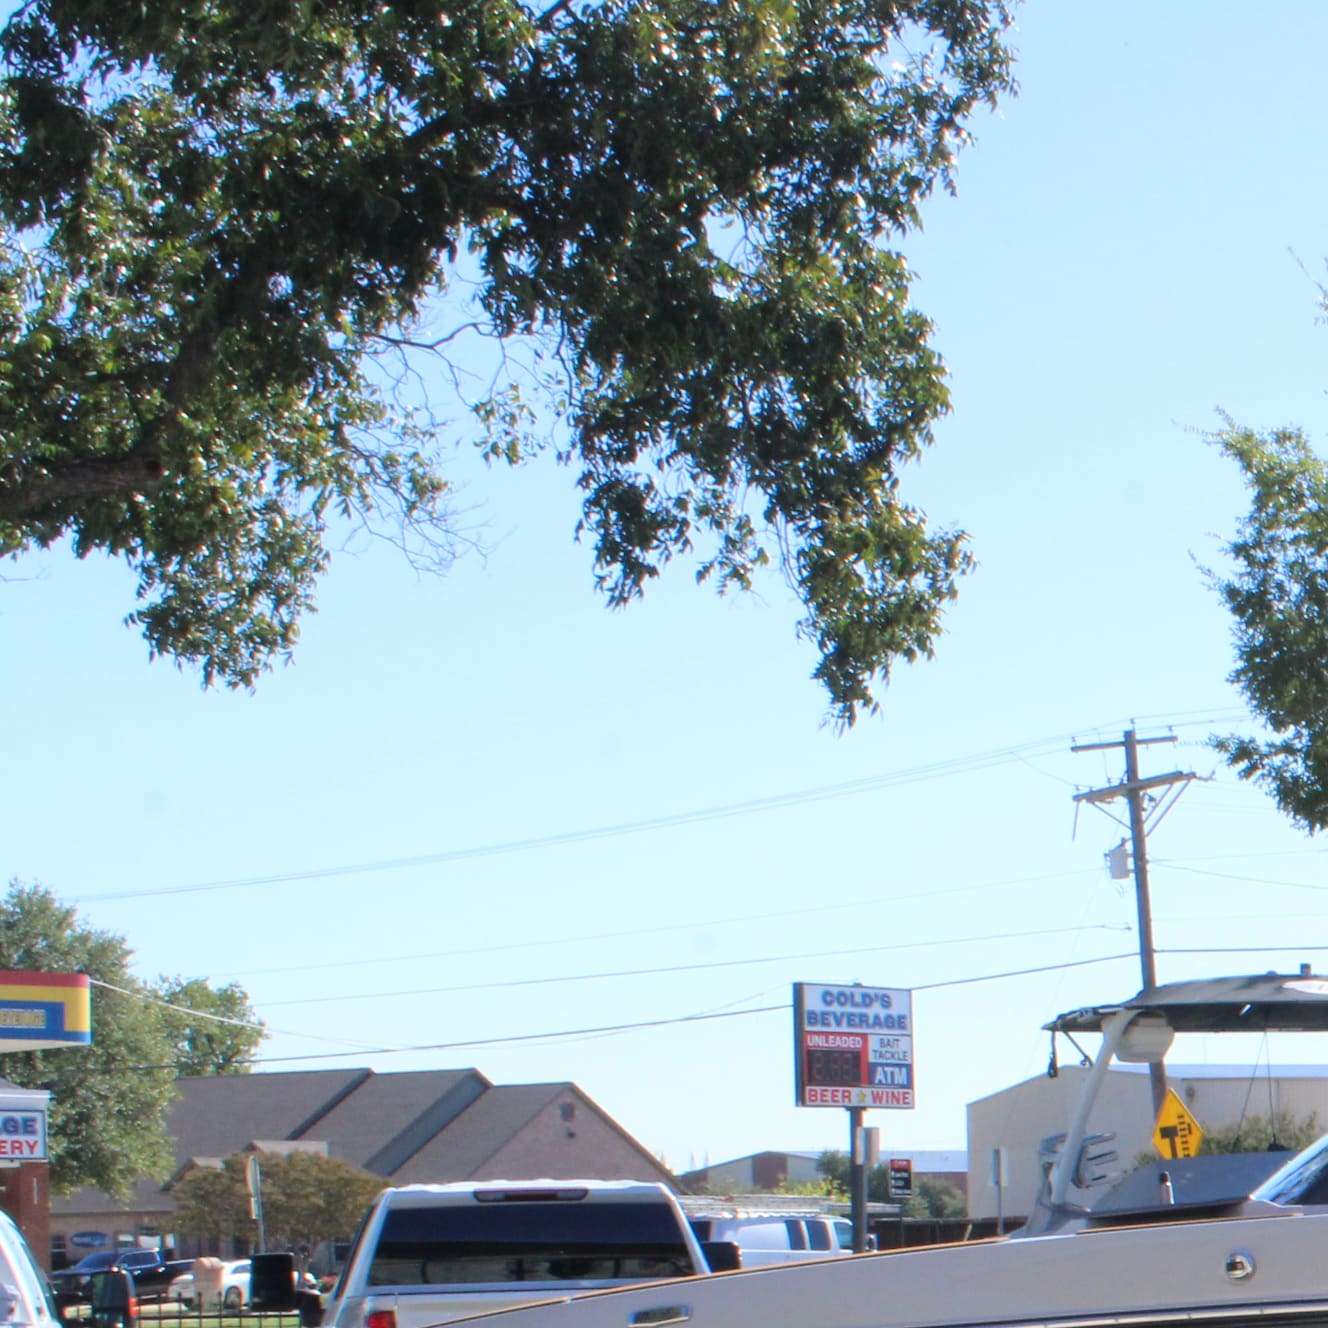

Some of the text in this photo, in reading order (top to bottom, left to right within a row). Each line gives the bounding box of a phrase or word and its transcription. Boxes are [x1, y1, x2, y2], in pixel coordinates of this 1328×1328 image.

[806, 1009, 908, 1030] BEVERAGE
[807, 1034, 863, 1048] UNLEADED
[879, 1038, 902, 1049] BAIT
[872, 1049, 909, 1062] TACKLE
[874, 1066, 908, 1085] ATM
[807, 1088, 911, 1105] BEER WINE
